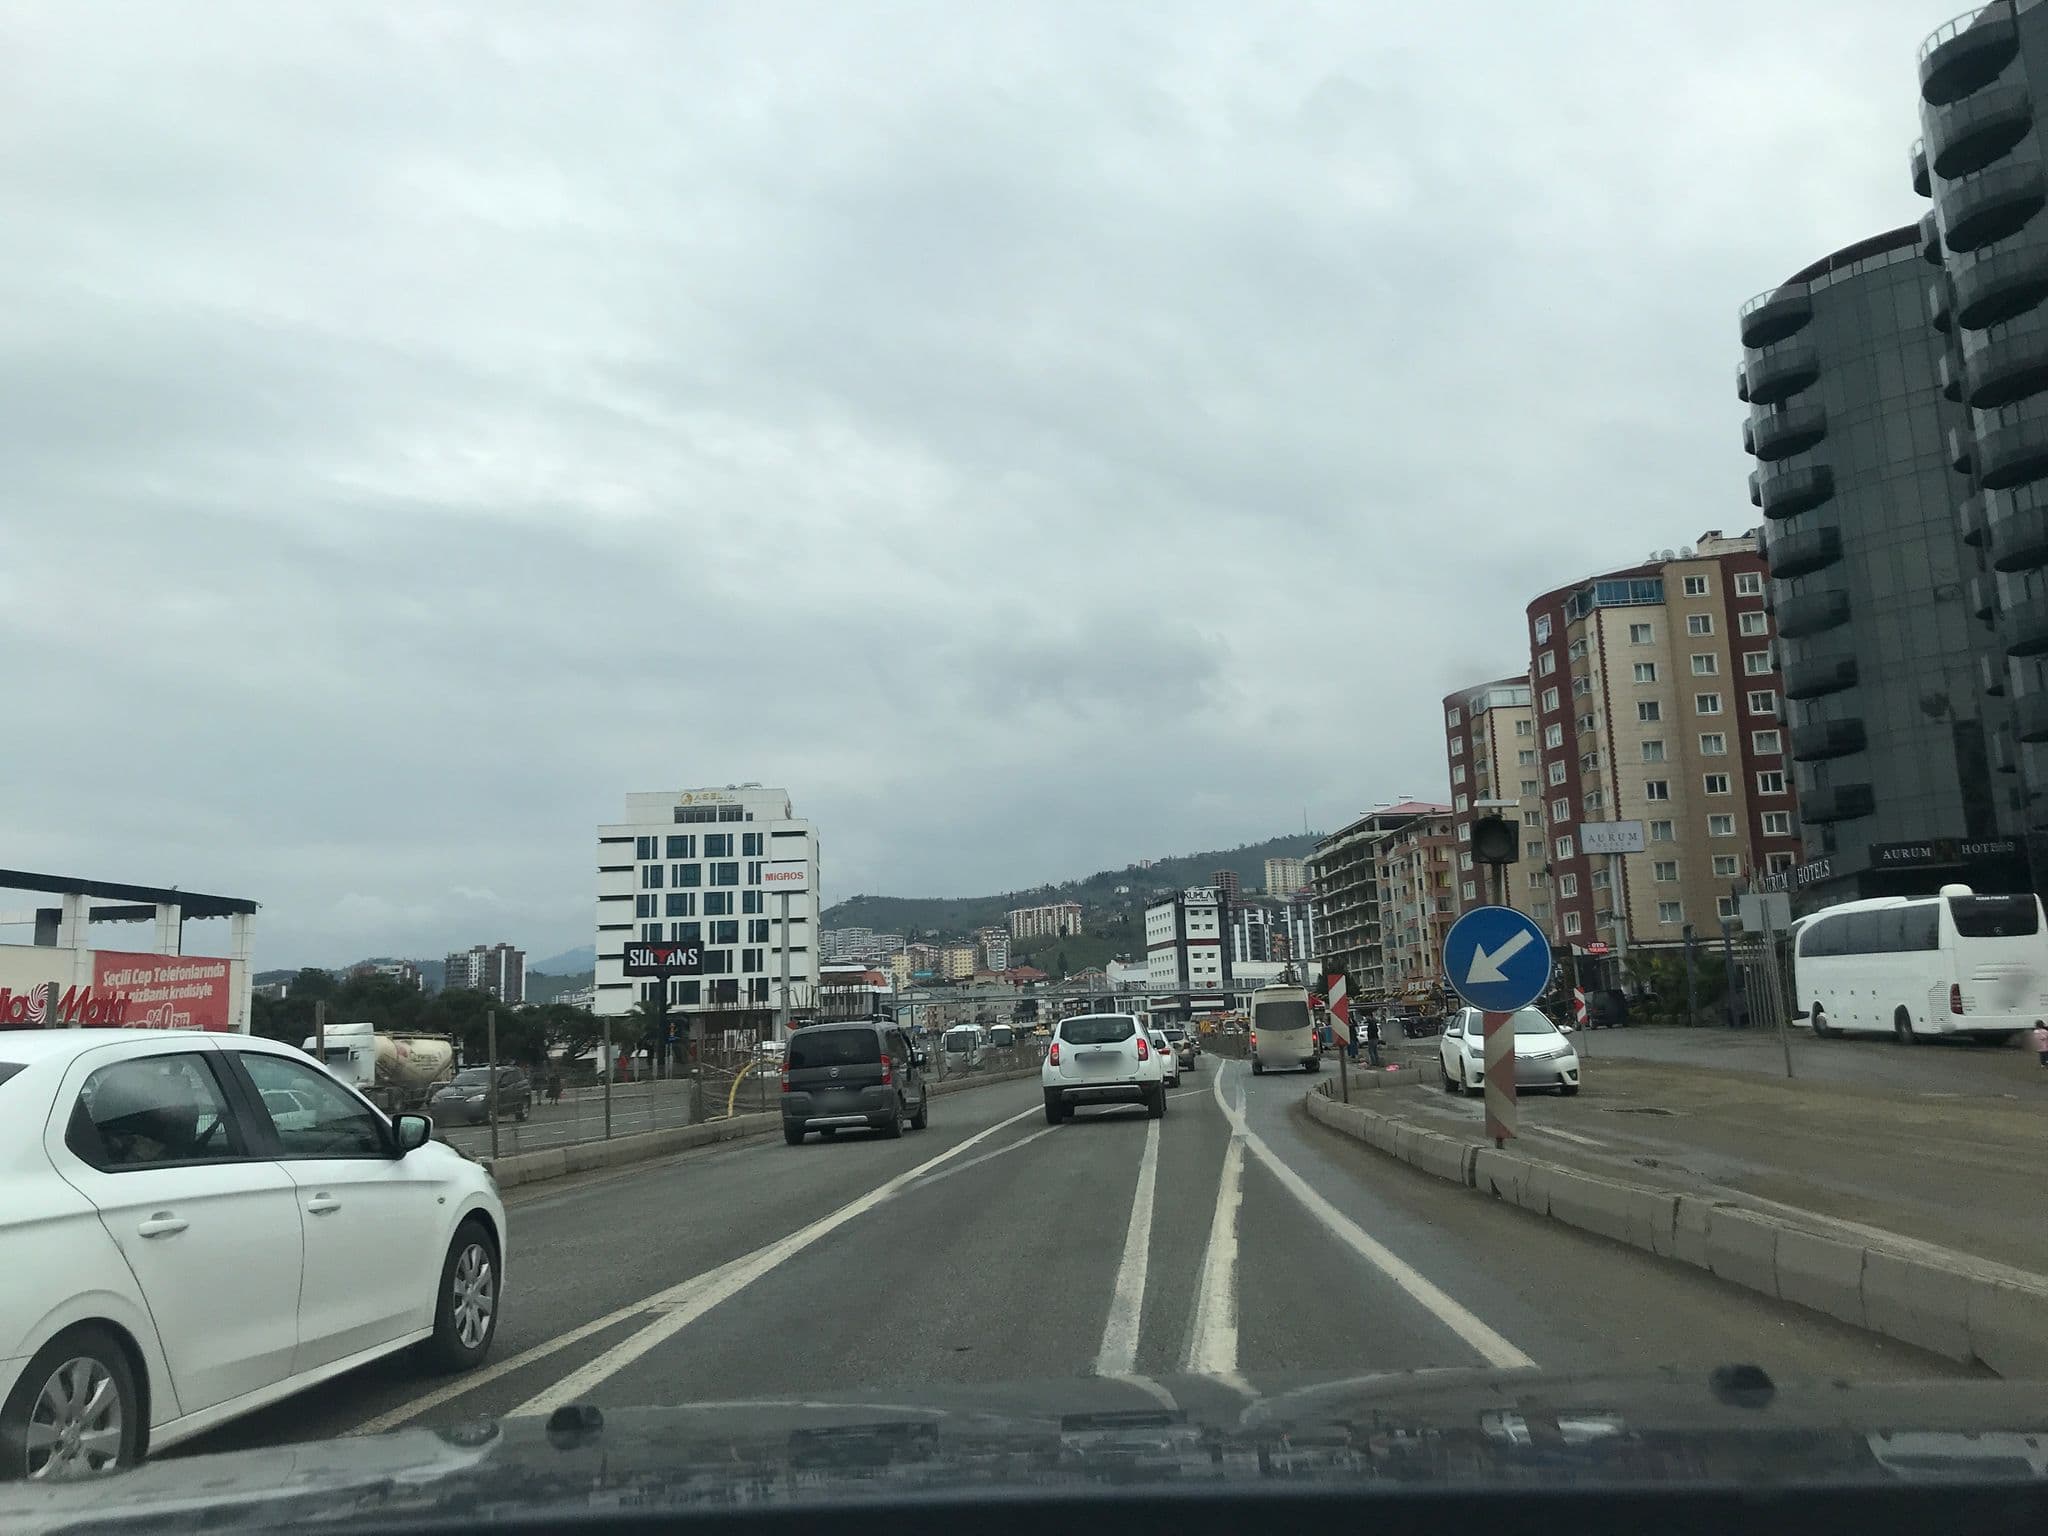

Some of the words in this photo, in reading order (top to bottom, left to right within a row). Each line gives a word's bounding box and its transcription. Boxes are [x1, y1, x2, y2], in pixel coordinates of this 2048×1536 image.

[1588, 832, 1638, 843] AURUM
[1883, 847, 1933, 860] AURUM
[1764, 872, 1788, 892] URUM
[1796, 859, 1831, 884] HOTELS
